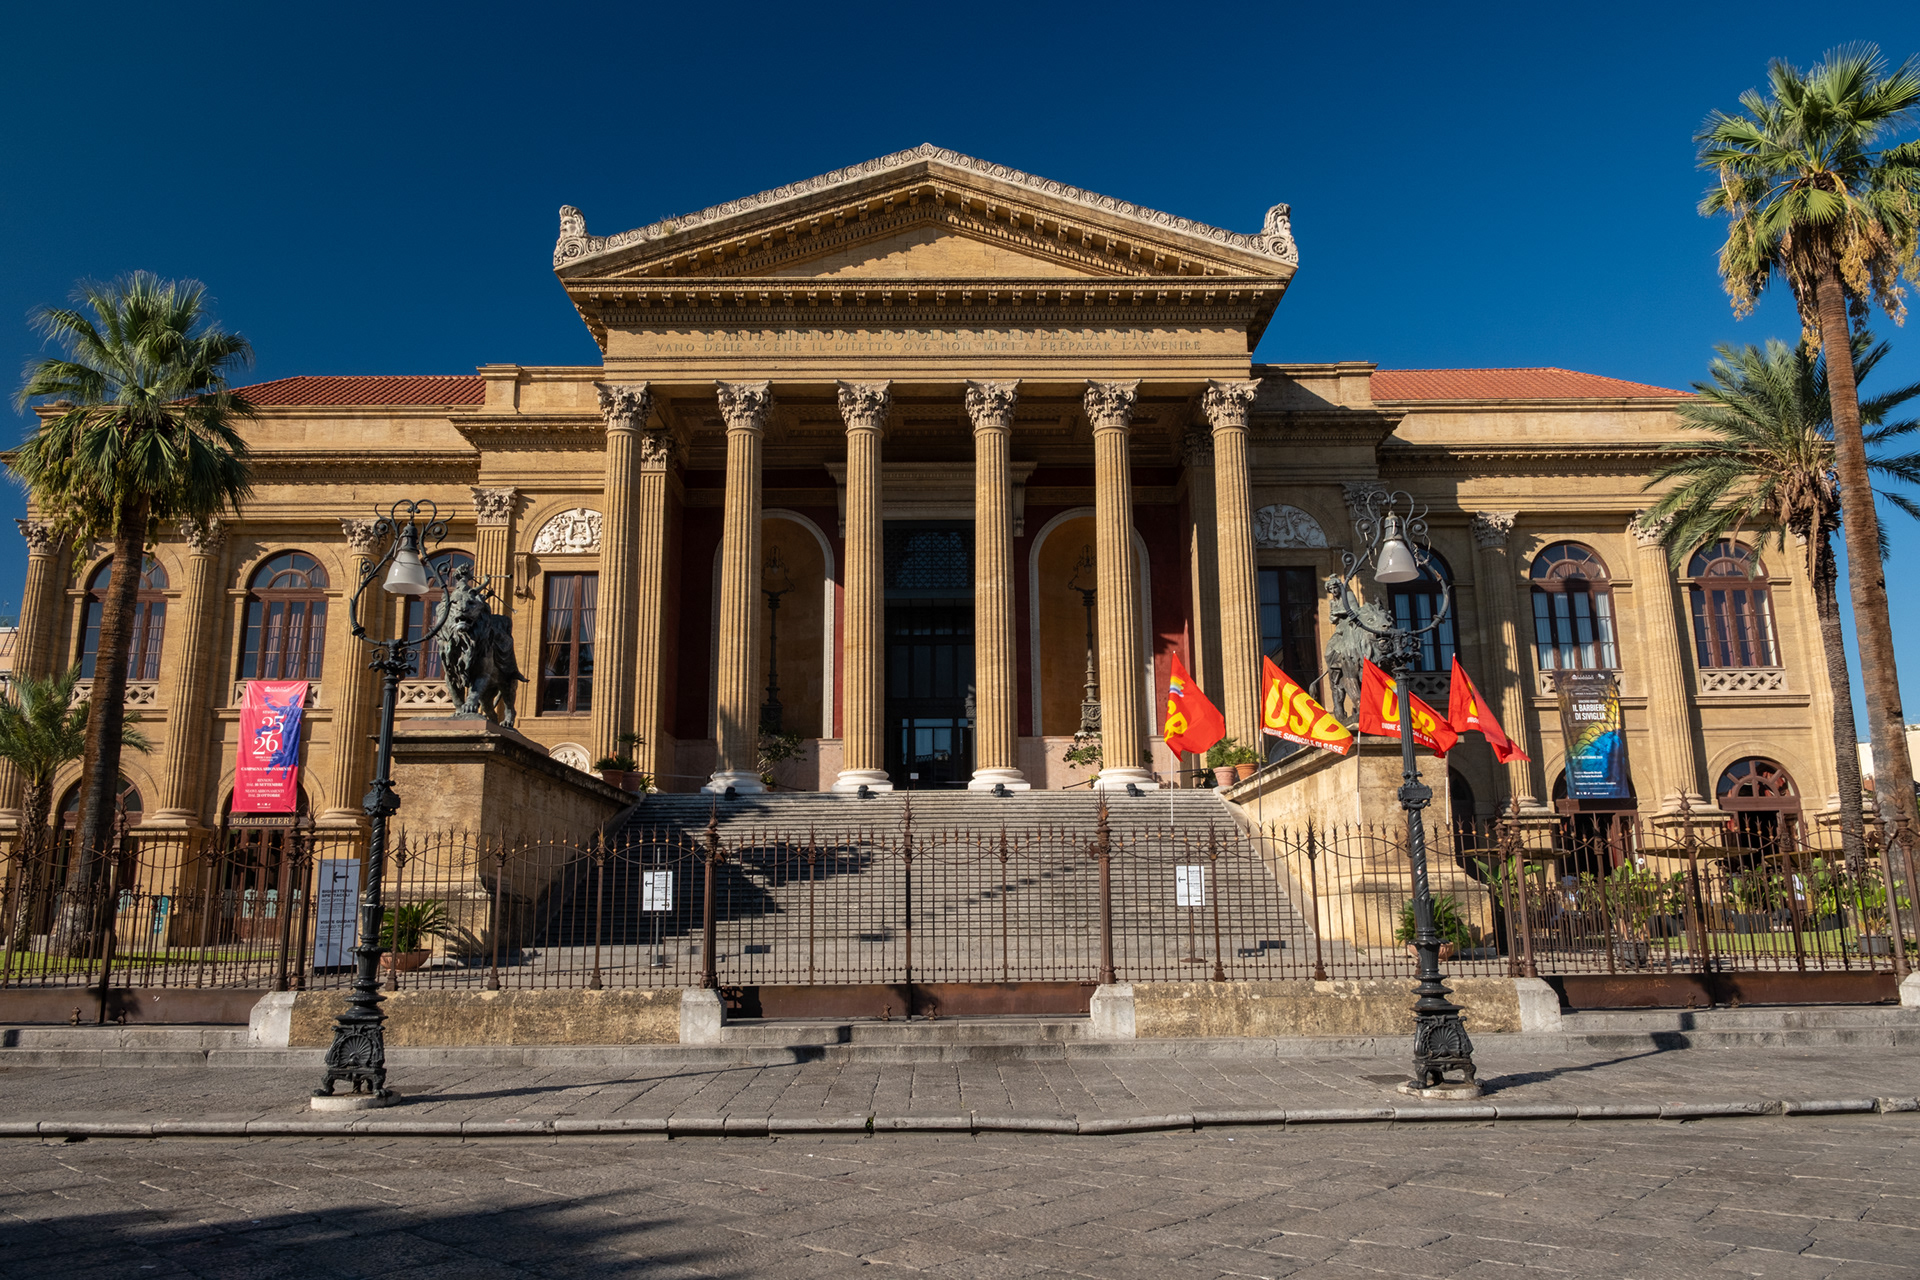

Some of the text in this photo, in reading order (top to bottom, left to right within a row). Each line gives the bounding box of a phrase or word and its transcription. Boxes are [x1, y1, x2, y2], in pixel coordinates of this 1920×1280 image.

[777, 329, 858, 341] RINNOVA
[883, 328, 945, 341] POPOLI
[974, 328, 996, 340] NE
[1007, 328, 1070, 340] RIVELA
[1081, 328, 1100, 340] LA
[1110, 328, 1152, 340] VITA
[657, 341, 1201, 352] VANO DELLE SCENE IL DILETTO OVE NON MIRI A PREPARAR L'AVVENIRE
[1572, 704, 1606, 712] IL BARBIERE
[261, 715, 285, 735] 25
[252, 734, 278, 755] 26
[1322, 743, 1344, 754] BASE
[232, 817, 293, 825] BIGLIETTER
